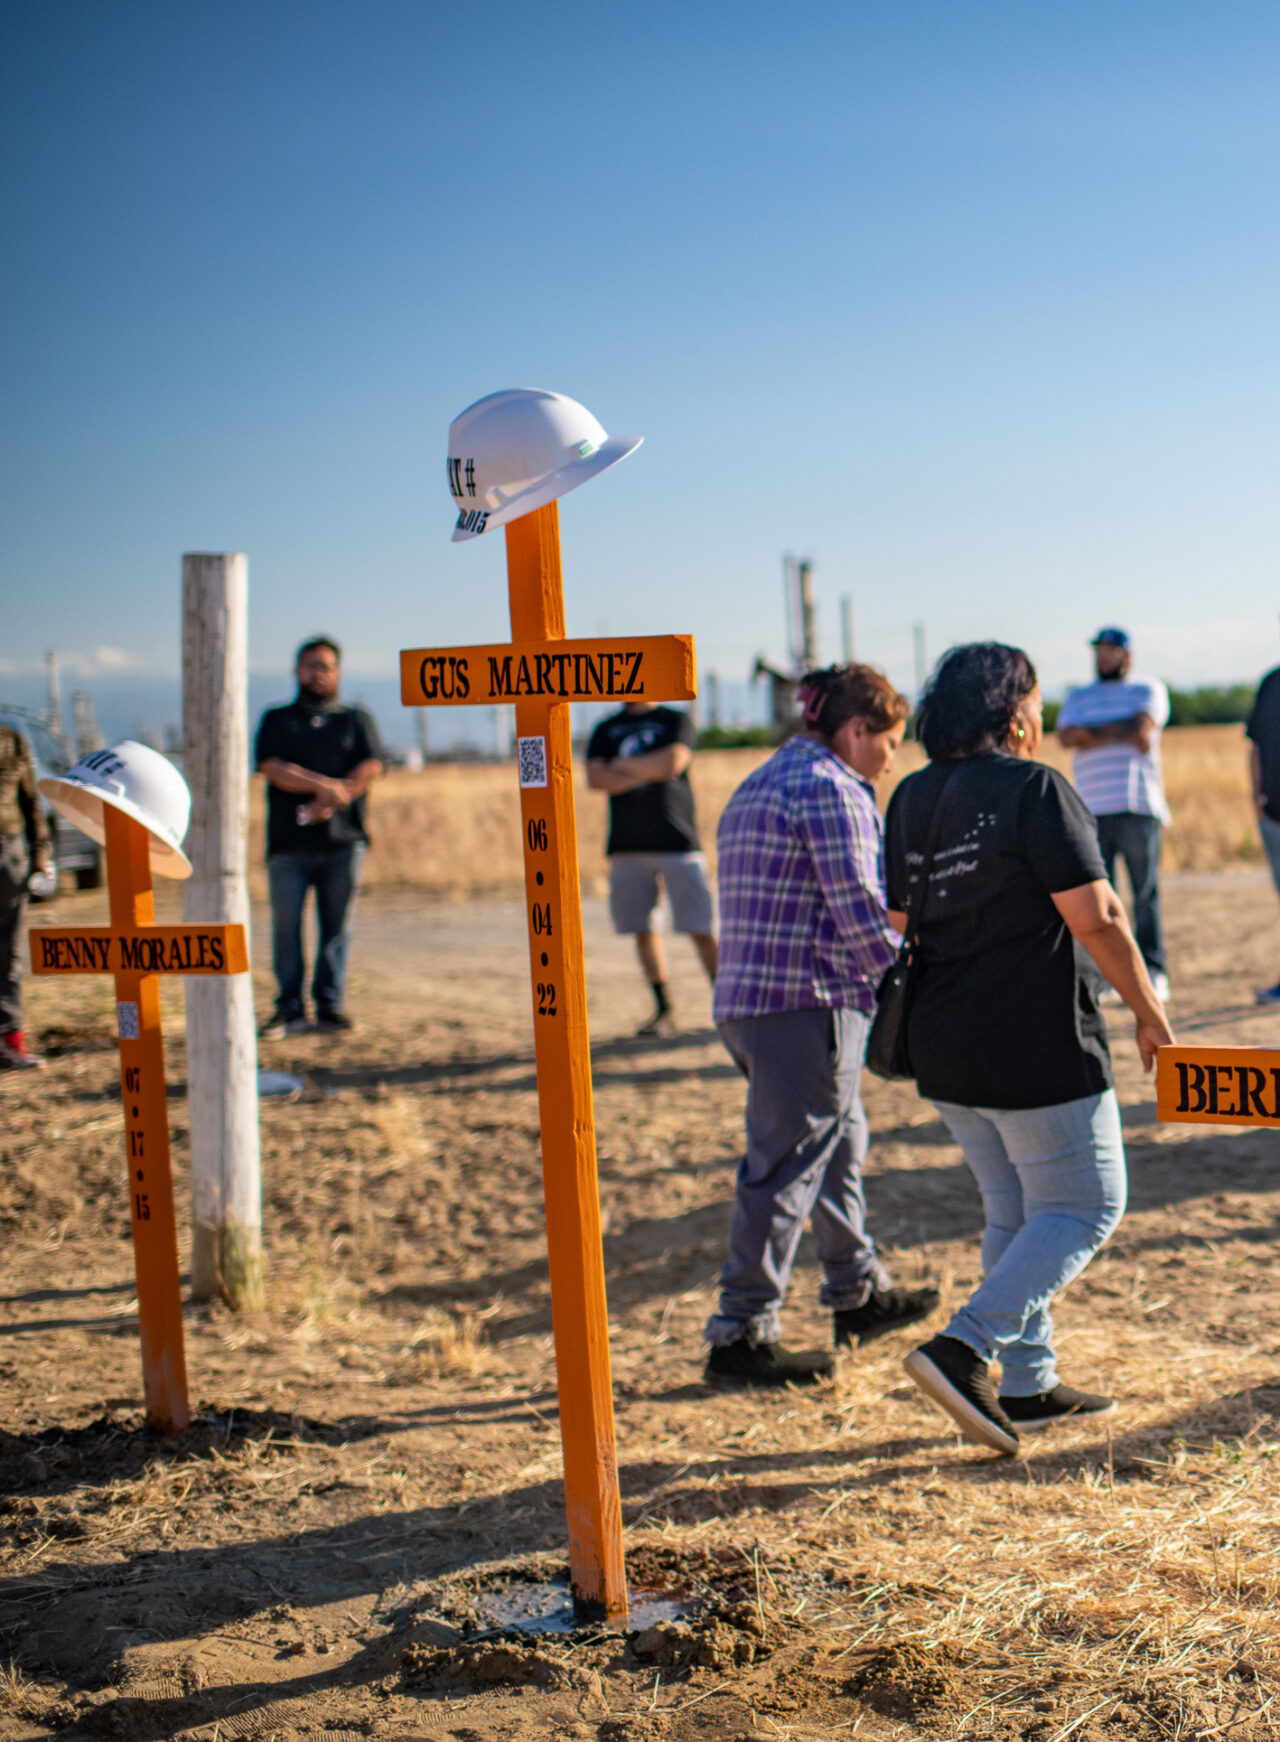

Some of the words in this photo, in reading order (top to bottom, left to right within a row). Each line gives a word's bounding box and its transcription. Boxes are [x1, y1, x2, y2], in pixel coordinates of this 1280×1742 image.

[419, 656, 471, 699] GUS
[487, 651, 645, 697] MARTINEZ
[527, 818, 548, 852] 06
[532, 902, 553, 936] 04
[40, 936, 111, 970] BENNY
[118, 934, 225, 971] MORALES
[536, 982, 558, 1017] 22
[125, 1066, 140, 1093] 07
[130, 1130, 144, 1158] 17
[135, 1194, 150, 1221] 15
